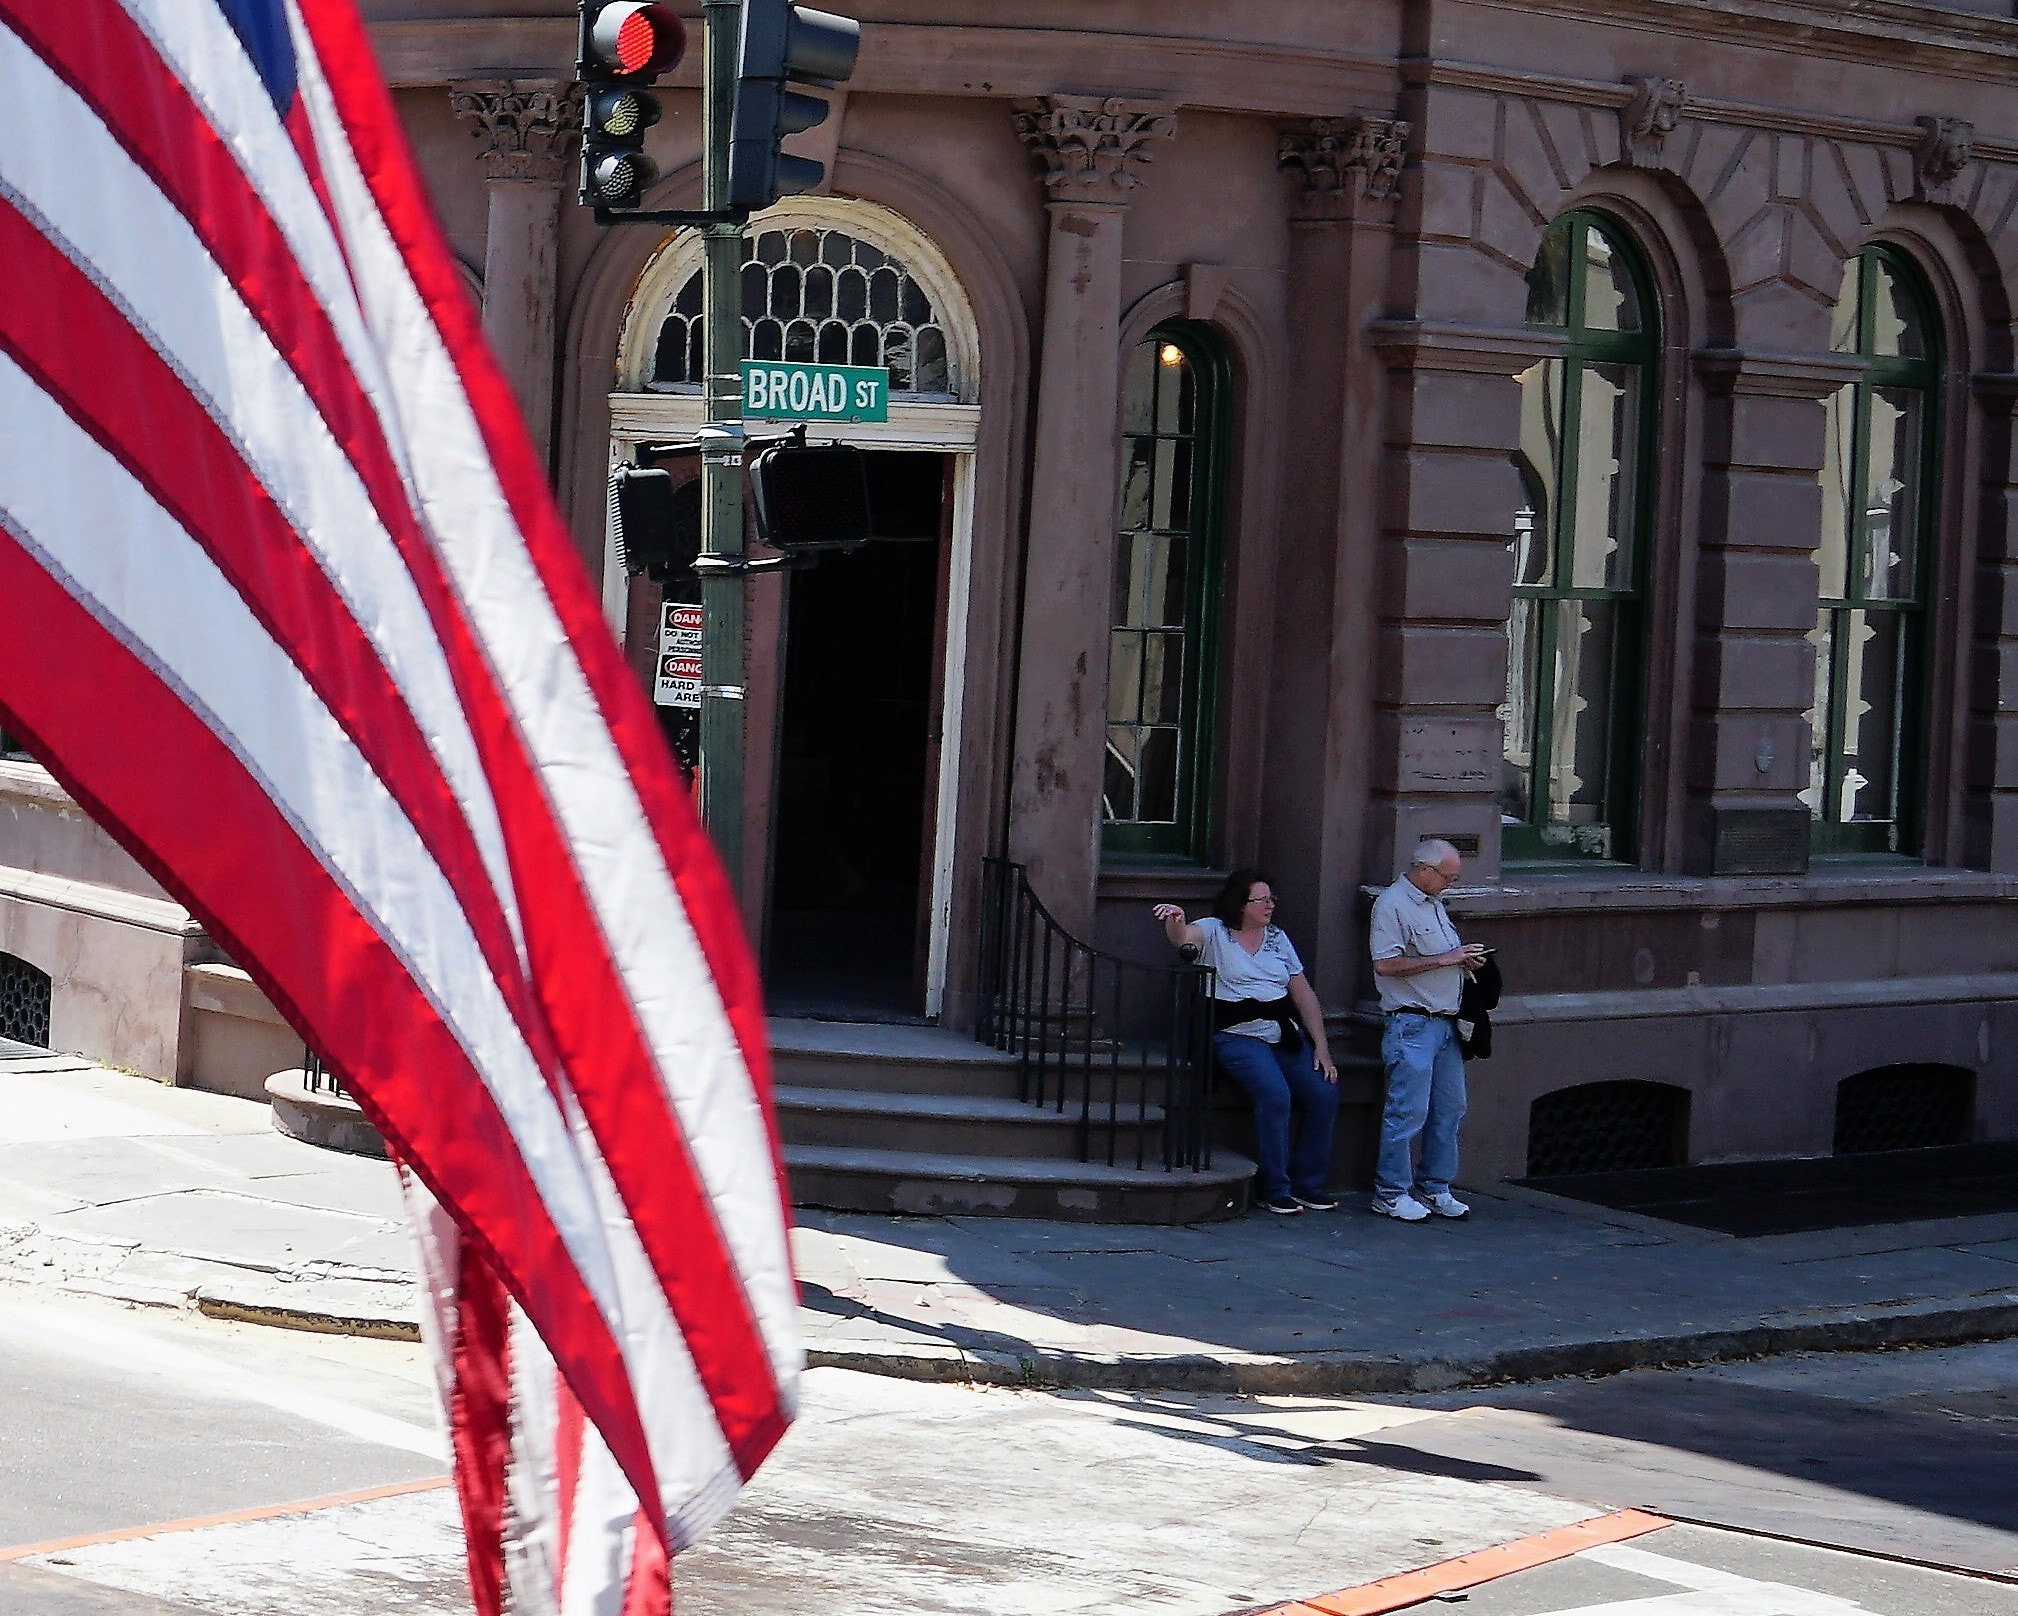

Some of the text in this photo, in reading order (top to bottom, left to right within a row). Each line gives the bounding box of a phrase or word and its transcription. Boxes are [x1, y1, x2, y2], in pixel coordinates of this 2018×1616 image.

[748, 368, 879, 413] BROAD ST
[673, 612, 702, 625] DAN
[661, 679, 695, 690] HARD
[674, 692, 700, 702] ARE
